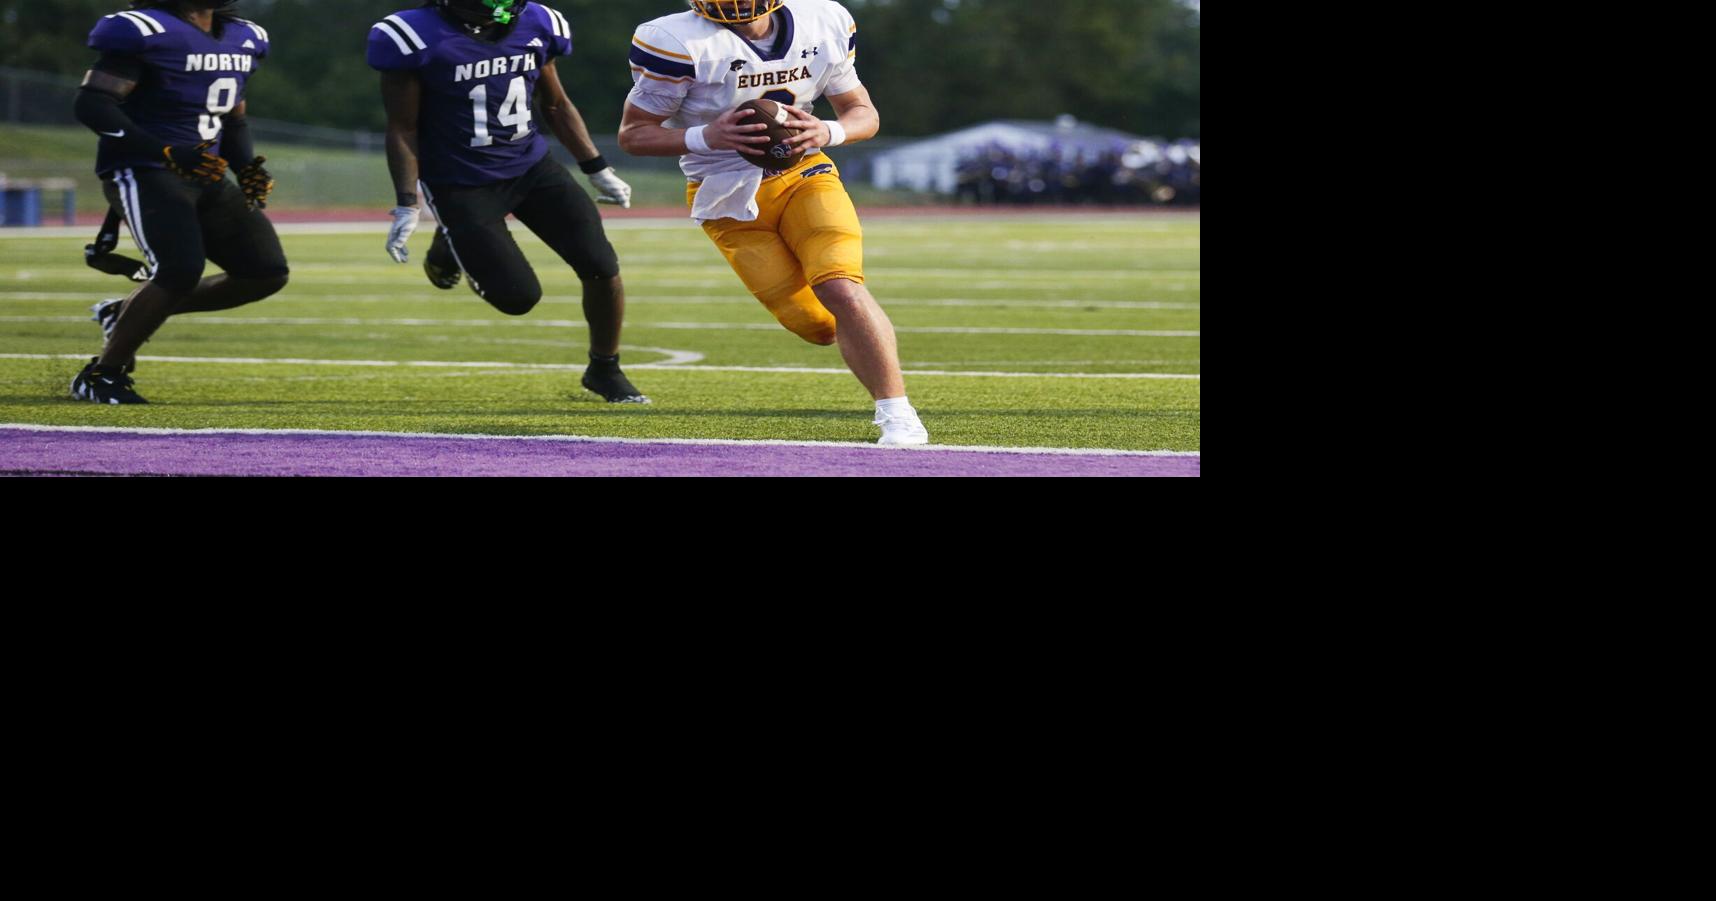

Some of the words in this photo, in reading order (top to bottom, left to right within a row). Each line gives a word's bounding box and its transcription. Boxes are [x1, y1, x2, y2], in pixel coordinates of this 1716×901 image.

[185, 53, 252, 72] NORTH
[453, 52, 537, 83] NORTH
[737, 65, 812, 89] EUREKA
[468, 75, 532, 147] 14
